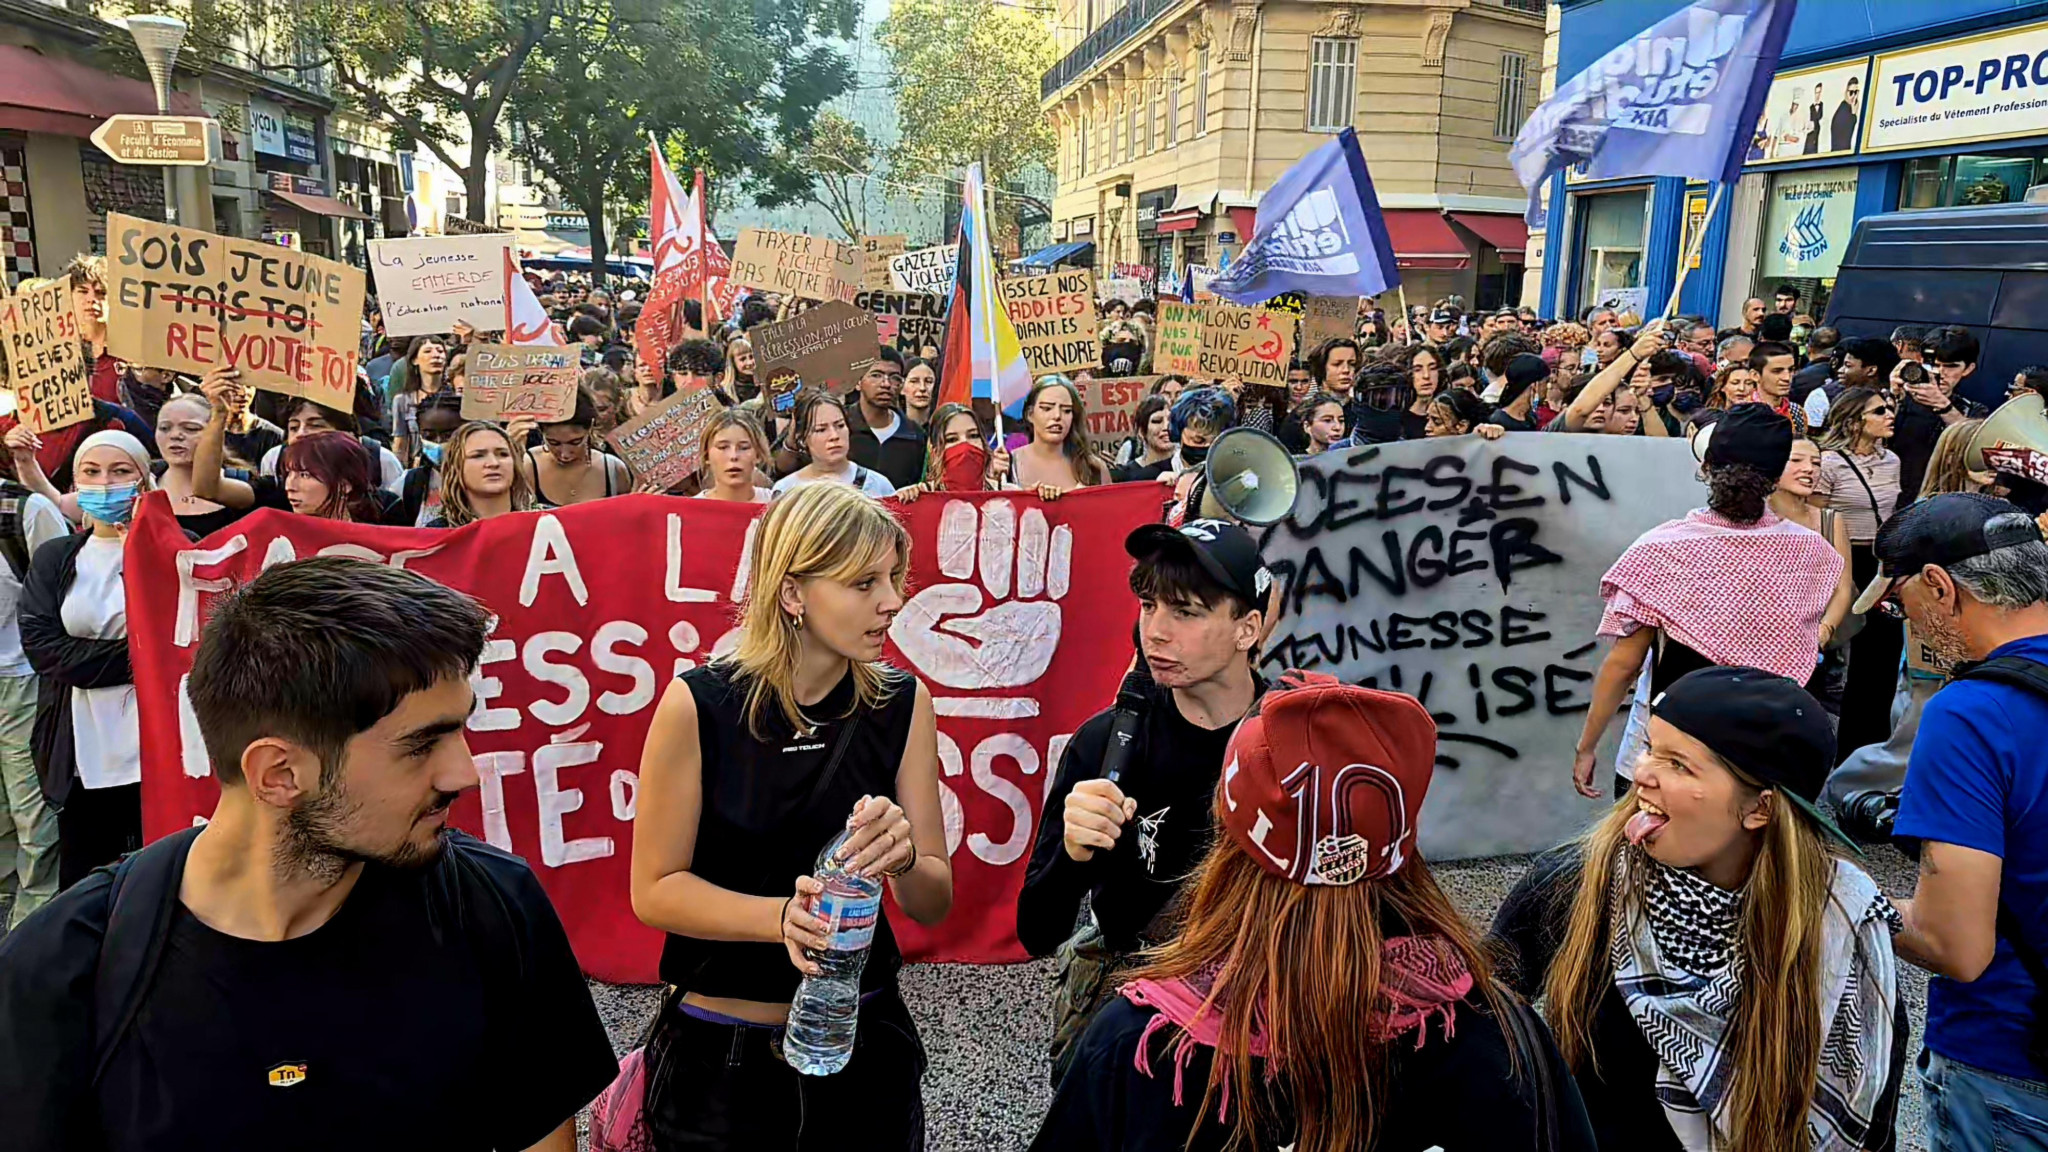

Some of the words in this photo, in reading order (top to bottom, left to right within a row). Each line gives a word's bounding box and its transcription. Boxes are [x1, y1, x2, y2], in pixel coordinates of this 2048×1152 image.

[1929, 112, 1942, 121] du
[1944, 106, 1991, 120] Vêtement
[1992, 98, 2048, 114] Profession
[120, 134, 150, 146] Faculté
[121, 148, 130, 158] et
[133, 147, 144, 158] de
[146, 147, 179, 158] Gestion
[377, 243, 404, 267] La
[413, 252, 478, 270] jeunesse
[752, 230, 812, 254] TAXER
[824, 240, 855, 265] LES
[893, 251, 937, 272] GAZEZ
[942, 248, 956, 264] LE
[778, 251, 832, 273] RICHES
[229, 250, 341, 304] JEUNE
[411, 270, 494, 290] EMMERDE
[734, 260, 767, 283] PAS
[774, 267, 821, 292] NOTRE
[1058, 274, 1088, 293] NOS
[120, 277, 161, 309] ET
[4, 303, 18, 331] 1
[21, 286, 62, 325] PROF
[1165, 306, 1184, 322] ON
[1205, 311, 1252, 330] LONG
[12, 317, 55, 357] POUR
[57, 311, 75, 337] 35
[1017, 317, 1078, 340] DIANT.ES
[1203, 332, 1239, 351] LIVE
[16, 341, 74, 379] ELEVES
[1199, 352, 1287, 381] REVOLUTION
[45, 387, 90, 425] ELEVE
[1101, 382, 1145, 406] EST
[1477, 454, 1611, 508] EN
[1259, 606, 1551, 671] JEUNESSE
[472, 722, 615, 868] TÉ
